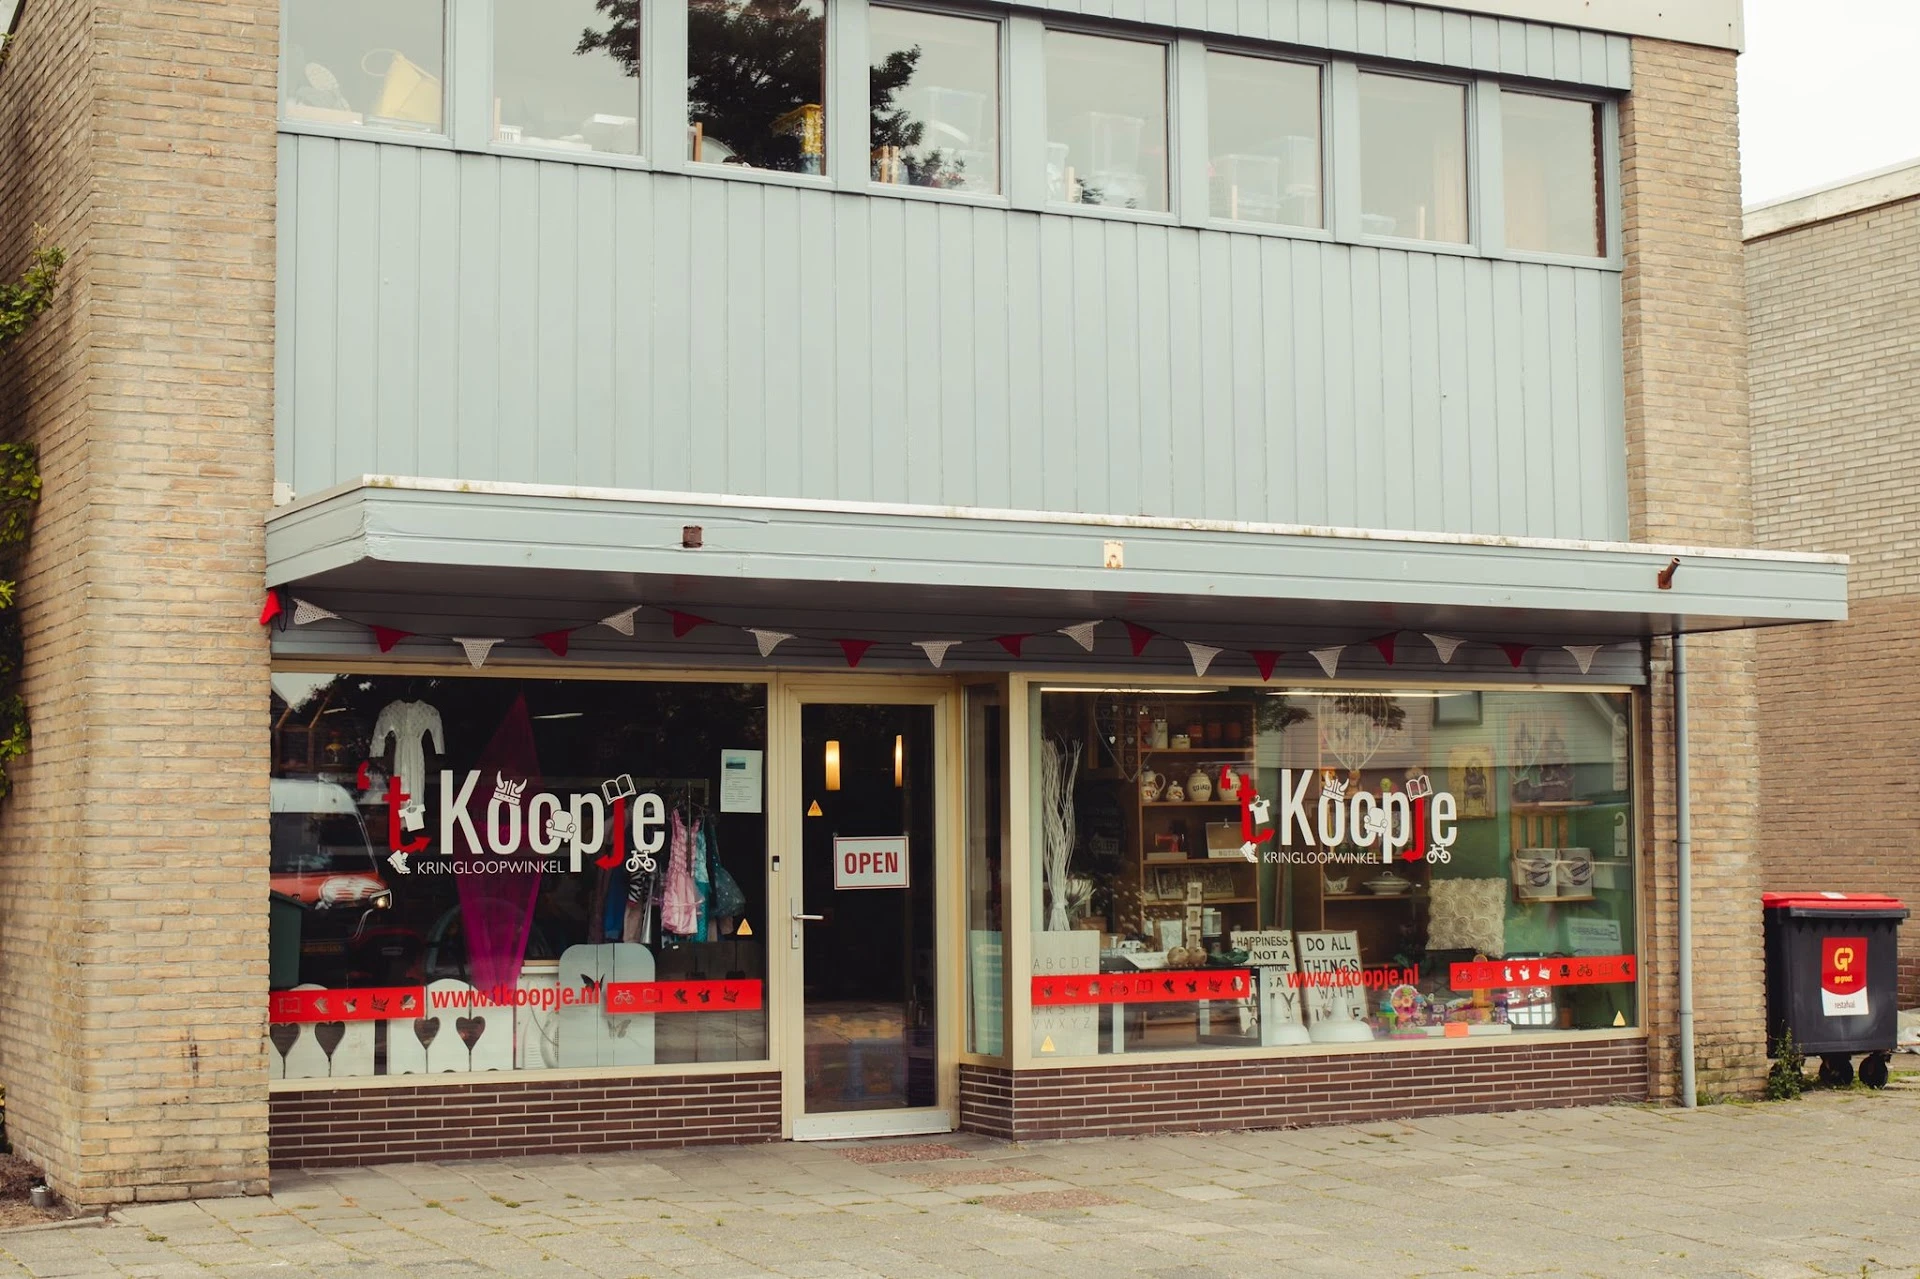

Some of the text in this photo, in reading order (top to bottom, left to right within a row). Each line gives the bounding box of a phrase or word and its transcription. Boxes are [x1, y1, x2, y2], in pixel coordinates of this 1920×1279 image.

[441, 769, 666, 873] Koopje
[1281, 769, 1457, 864] Koopje
[844, 852, 898, 875] OPEN
[1263, 851, 1379, 864] KRINGLOOPWINKEL
[416, 861, 565, 876] KRINGLOOPWINKEL
[1237, 937, 1289, 947] HAPPINESS
[1306, 937, 1351, 952] DO ALL
[1253, 950, 1290, 960] NOT A
[1304, 958, 1360, 974] THINGS
[1286, 963, 1419, 991] www.tkoopje.nl
[431, 980, 600, 1011] www.tkoopje.nl
